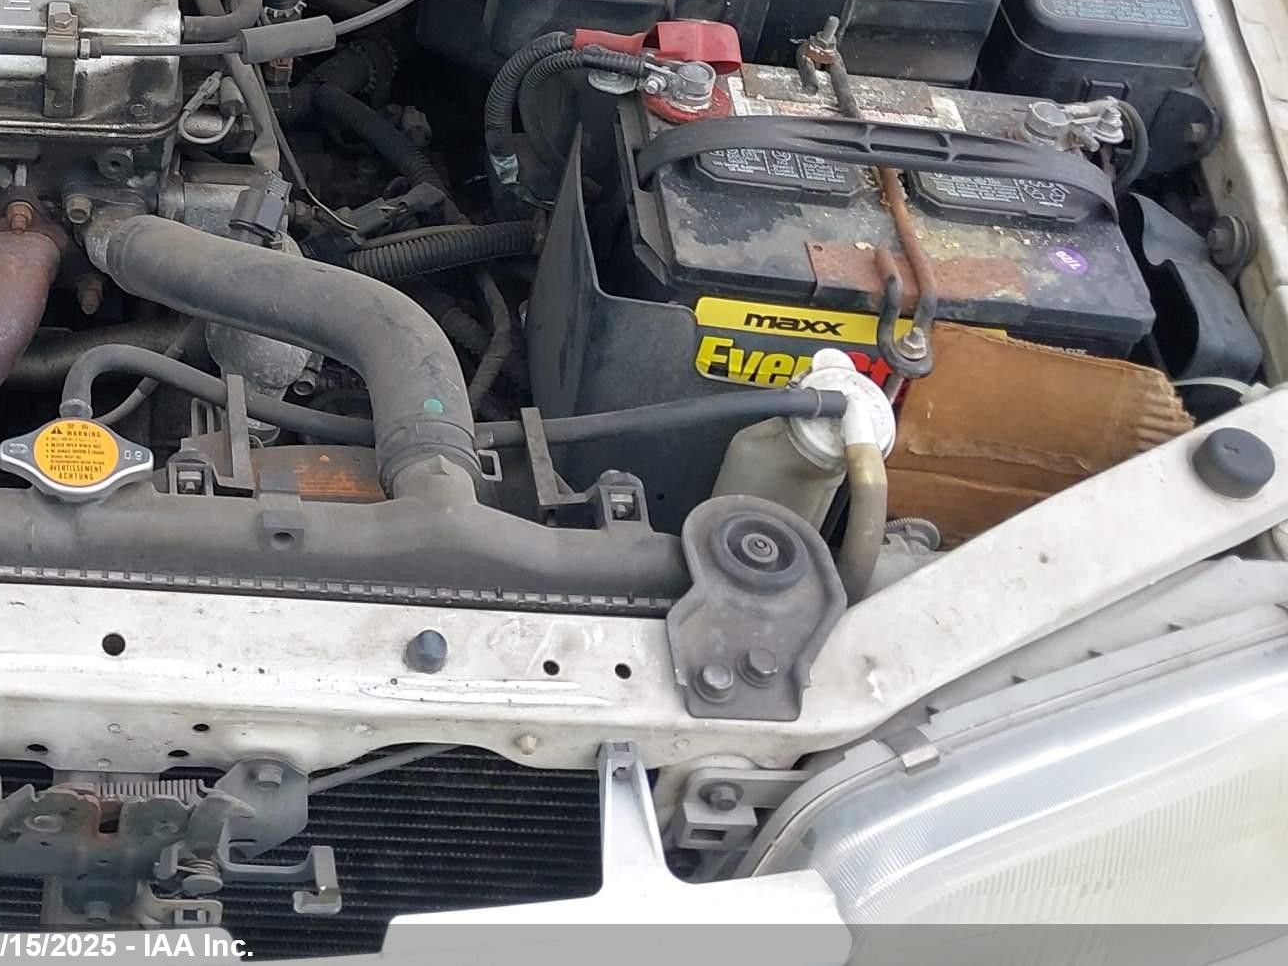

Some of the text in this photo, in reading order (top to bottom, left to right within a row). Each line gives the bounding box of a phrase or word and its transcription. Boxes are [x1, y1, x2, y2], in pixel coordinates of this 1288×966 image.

[744, 313, 846, 336] maxx
[66, 430, 102, 438] WARNING
[124, 449, 143, 461] 0.9
[50, 464, 102, 474] AVERTISSEMENT
[59, 472, 94, 480] ACHTUNG
